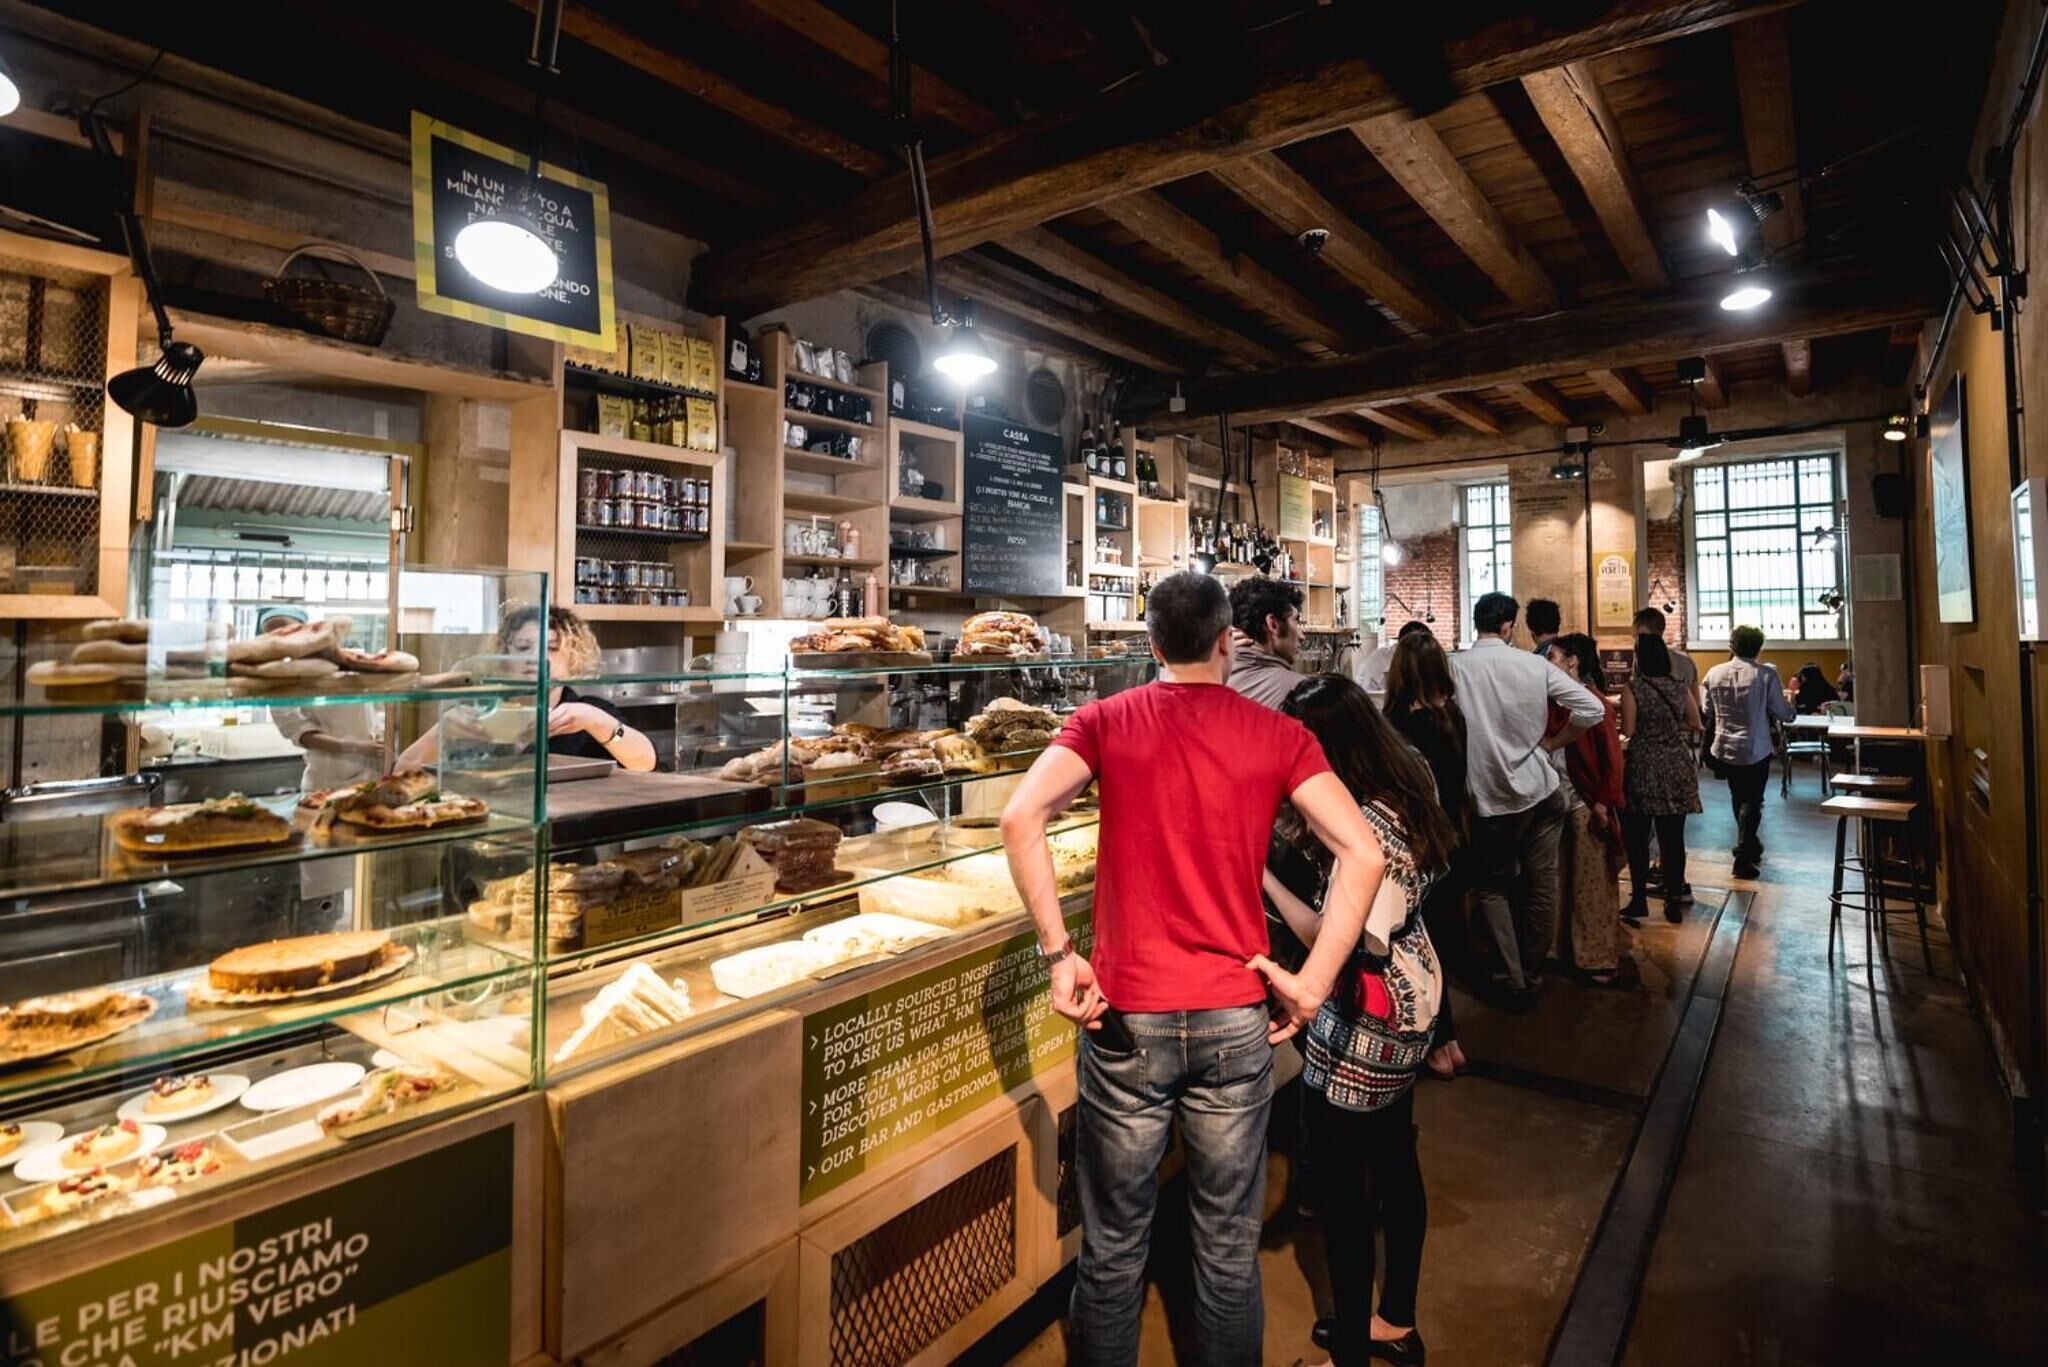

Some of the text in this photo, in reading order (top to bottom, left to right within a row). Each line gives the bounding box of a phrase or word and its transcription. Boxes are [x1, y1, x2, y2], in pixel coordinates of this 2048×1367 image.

[463, 170, 572, 217] IN UN A
[1003, 429, 1029, 442] CASSA
[823, 944, 1035, 1043] LOCALLY SOURCED INGREDIENTS
[823, 1058, 846, 1080] TO
[850, 1043, 881, 1069] ASK
[886, 1033, 905, 1052] US
[910, 1013, 948, 1042] WHAT
[909, 1000, 940, 1024] THIS
[944, 993, 957, 1010] IS
[961, 981, 985, 1002] THE
[988, 968, 1016, 991] BEST
[1020, 960, 1036, 977] WE
[820, 1145, 854, 1174] OUR
[859, 1127, 889, 1155] BAR
[893, 1110, 922, 1137] AND
[926, 1064, 1013, 1118] GASTRONOMY
[1013, 1049, 1034, 1071] ARE
[1037, 1036, 1063, 1057] OPEN
[821, 1024, 1041, 1147] DISCOVER MORE ON OUR WEBSITE
[822, 1076, 867, 1110] MORE
[872, 1054, 912, 1085] THAN
[916, 1042, 939, 1065] 100
[942, 1022, 983, 1052] SMALL
[987, 1000, 1031, 1029] ITALIAN
[822, 1101, 853, 1129] FOR
[896, 1069, 917, 1091] WE
[921, 1048, 960, 1079] KNOW
[964, 1032, 996, 1057] THEM
[1000, 1020, 1020, 1040] ALL
[1025, 1007, 1047, 1027] ONE
[60, 1233, 370, 1367] CHE RIUSCIAMO
[79, 1281, 160, 1332] PER
[174, 1271, 183, 1297] I
[198, 1216, 333, 1287] NOSTRI
